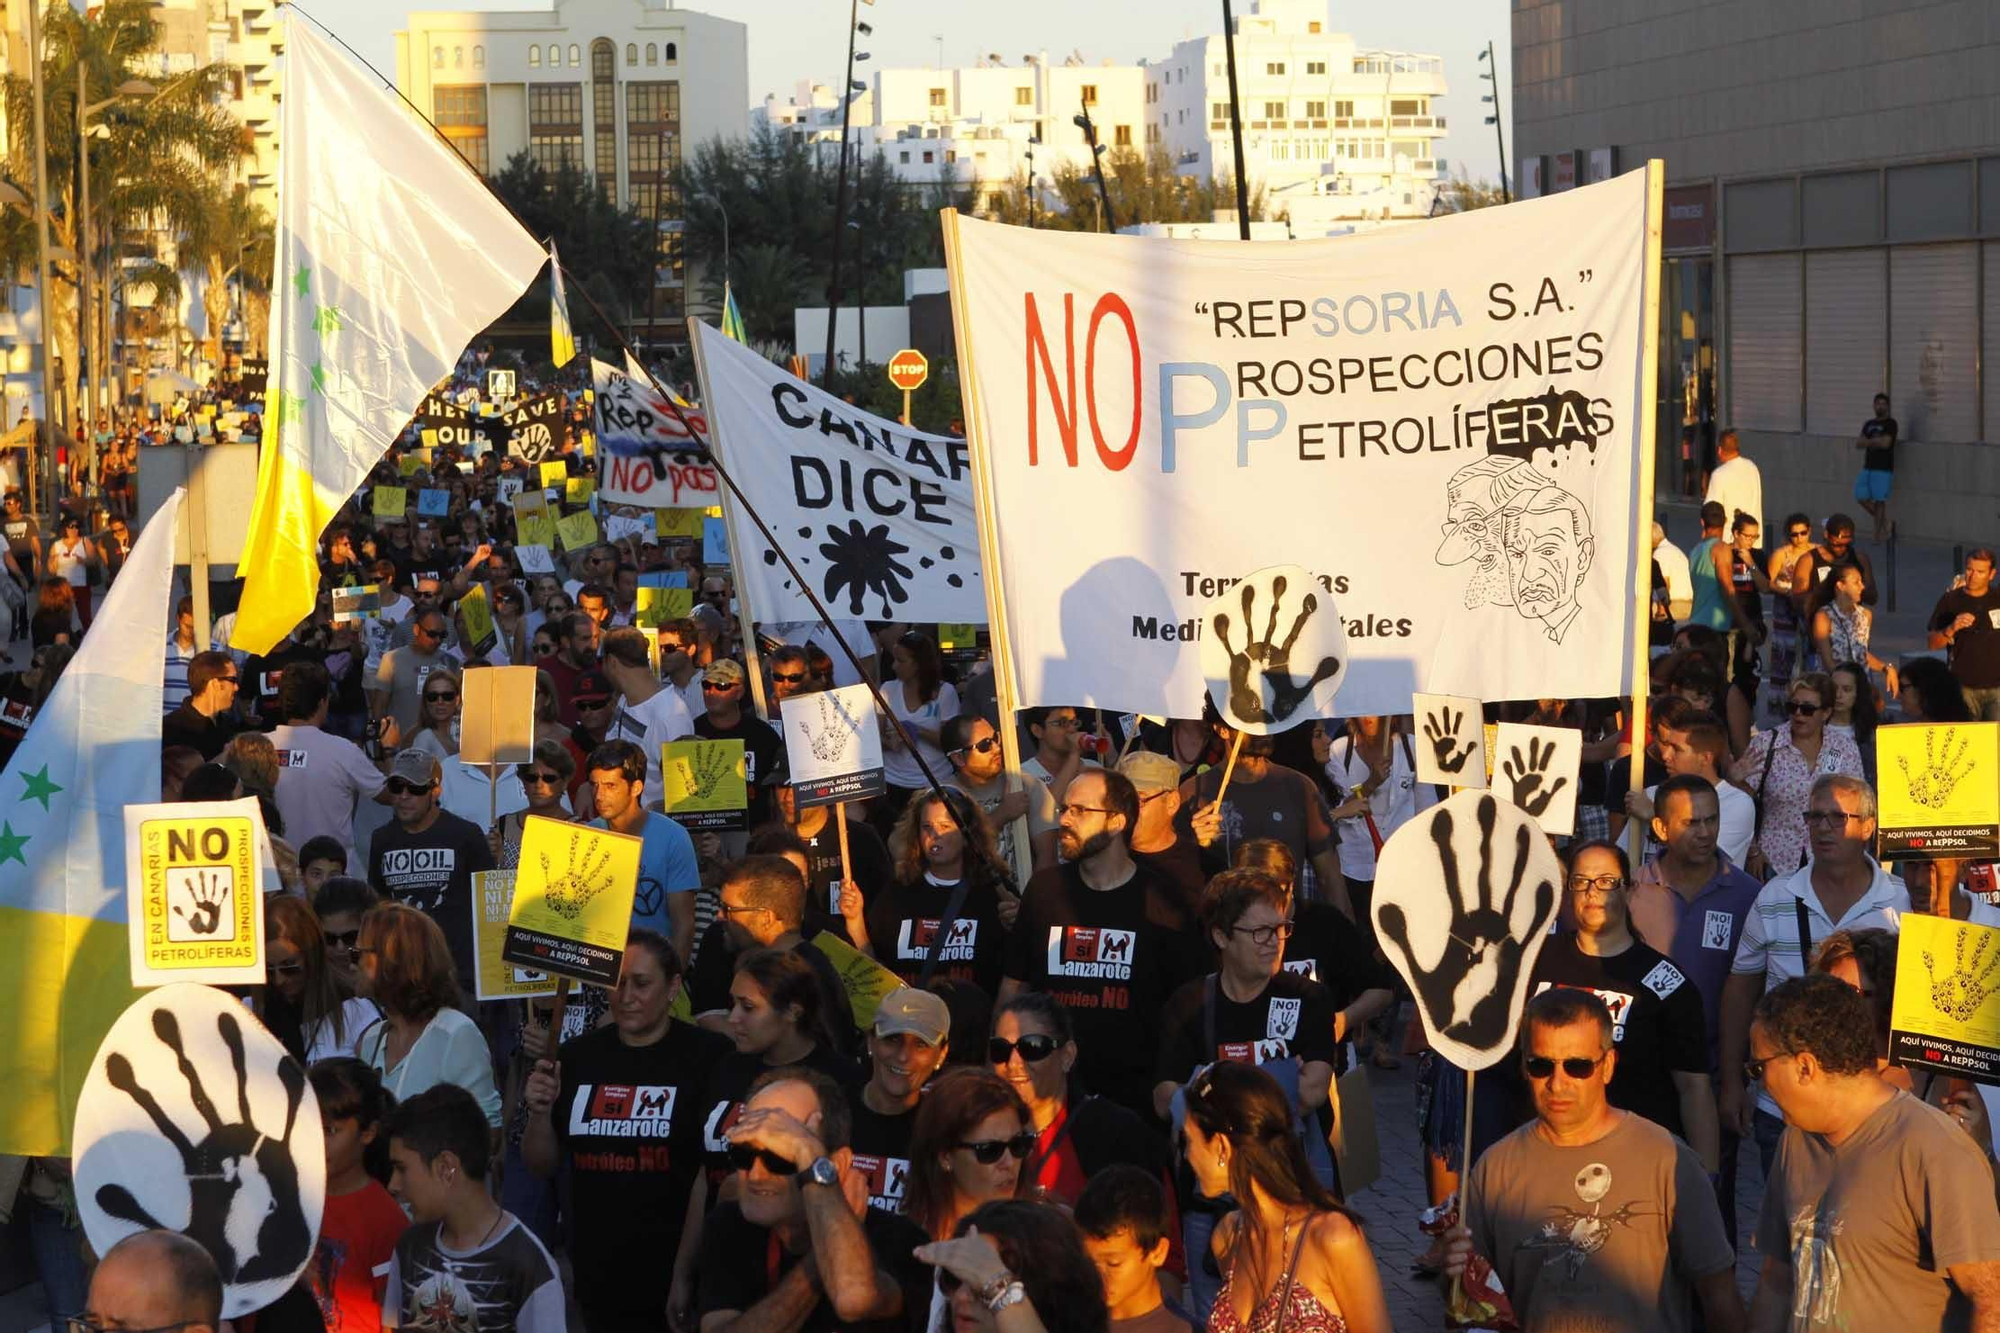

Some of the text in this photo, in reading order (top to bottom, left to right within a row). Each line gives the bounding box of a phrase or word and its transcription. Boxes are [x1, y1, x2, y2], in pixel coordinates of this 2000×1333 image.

[893, 364, 925, 375] STOP
[1025, 292, 1141, 471] NO
[504, 397, 557, 427] SAVE
[790, 455, 952, 526] DICE
[168, 827, 229, 862] NO
[1887, 830, 1903, 839] AQUÍ
[1936, 829, 1952, 837] AQUÍ
[1953, 828, 1990, 837] DECIDIMOS
[1910, 839, 1924, 848] NO
[383, 850, 453, 873] NO OIL
[148, 830, 163, 945] EN CANARIAS
[238, 828, 251, 943] PROSPECCIONES
[485, 891, 502, 903] NI
[486, 904, 498, 914] NI
[1711, 913, 1730, 924] NO!
[152, 945, 252, 962] PETROLÍFERAS
[514, 931, 531, 942] AQUÍ
[561, 942, 578, 954] AQUÍ
[578, 945, 613, 961] DECIDIMOS
[1048, 926, 1131, 980] Lanzarote
[1662, 964, 1683, 983] NO!
[1102, 985, 1129, 1008] NO
[1275, 1000, 1298, 1011] NO!
[1900, 1036, 1920, 1046] AQUÍ
[1955, 1046, 1975, 1057] AQUÍ
[1925, 1050, 1941, 1061] NO
[1943, 1054, 1949, 1062] A
[569, 1085, 671, 1138] Lanzarote
